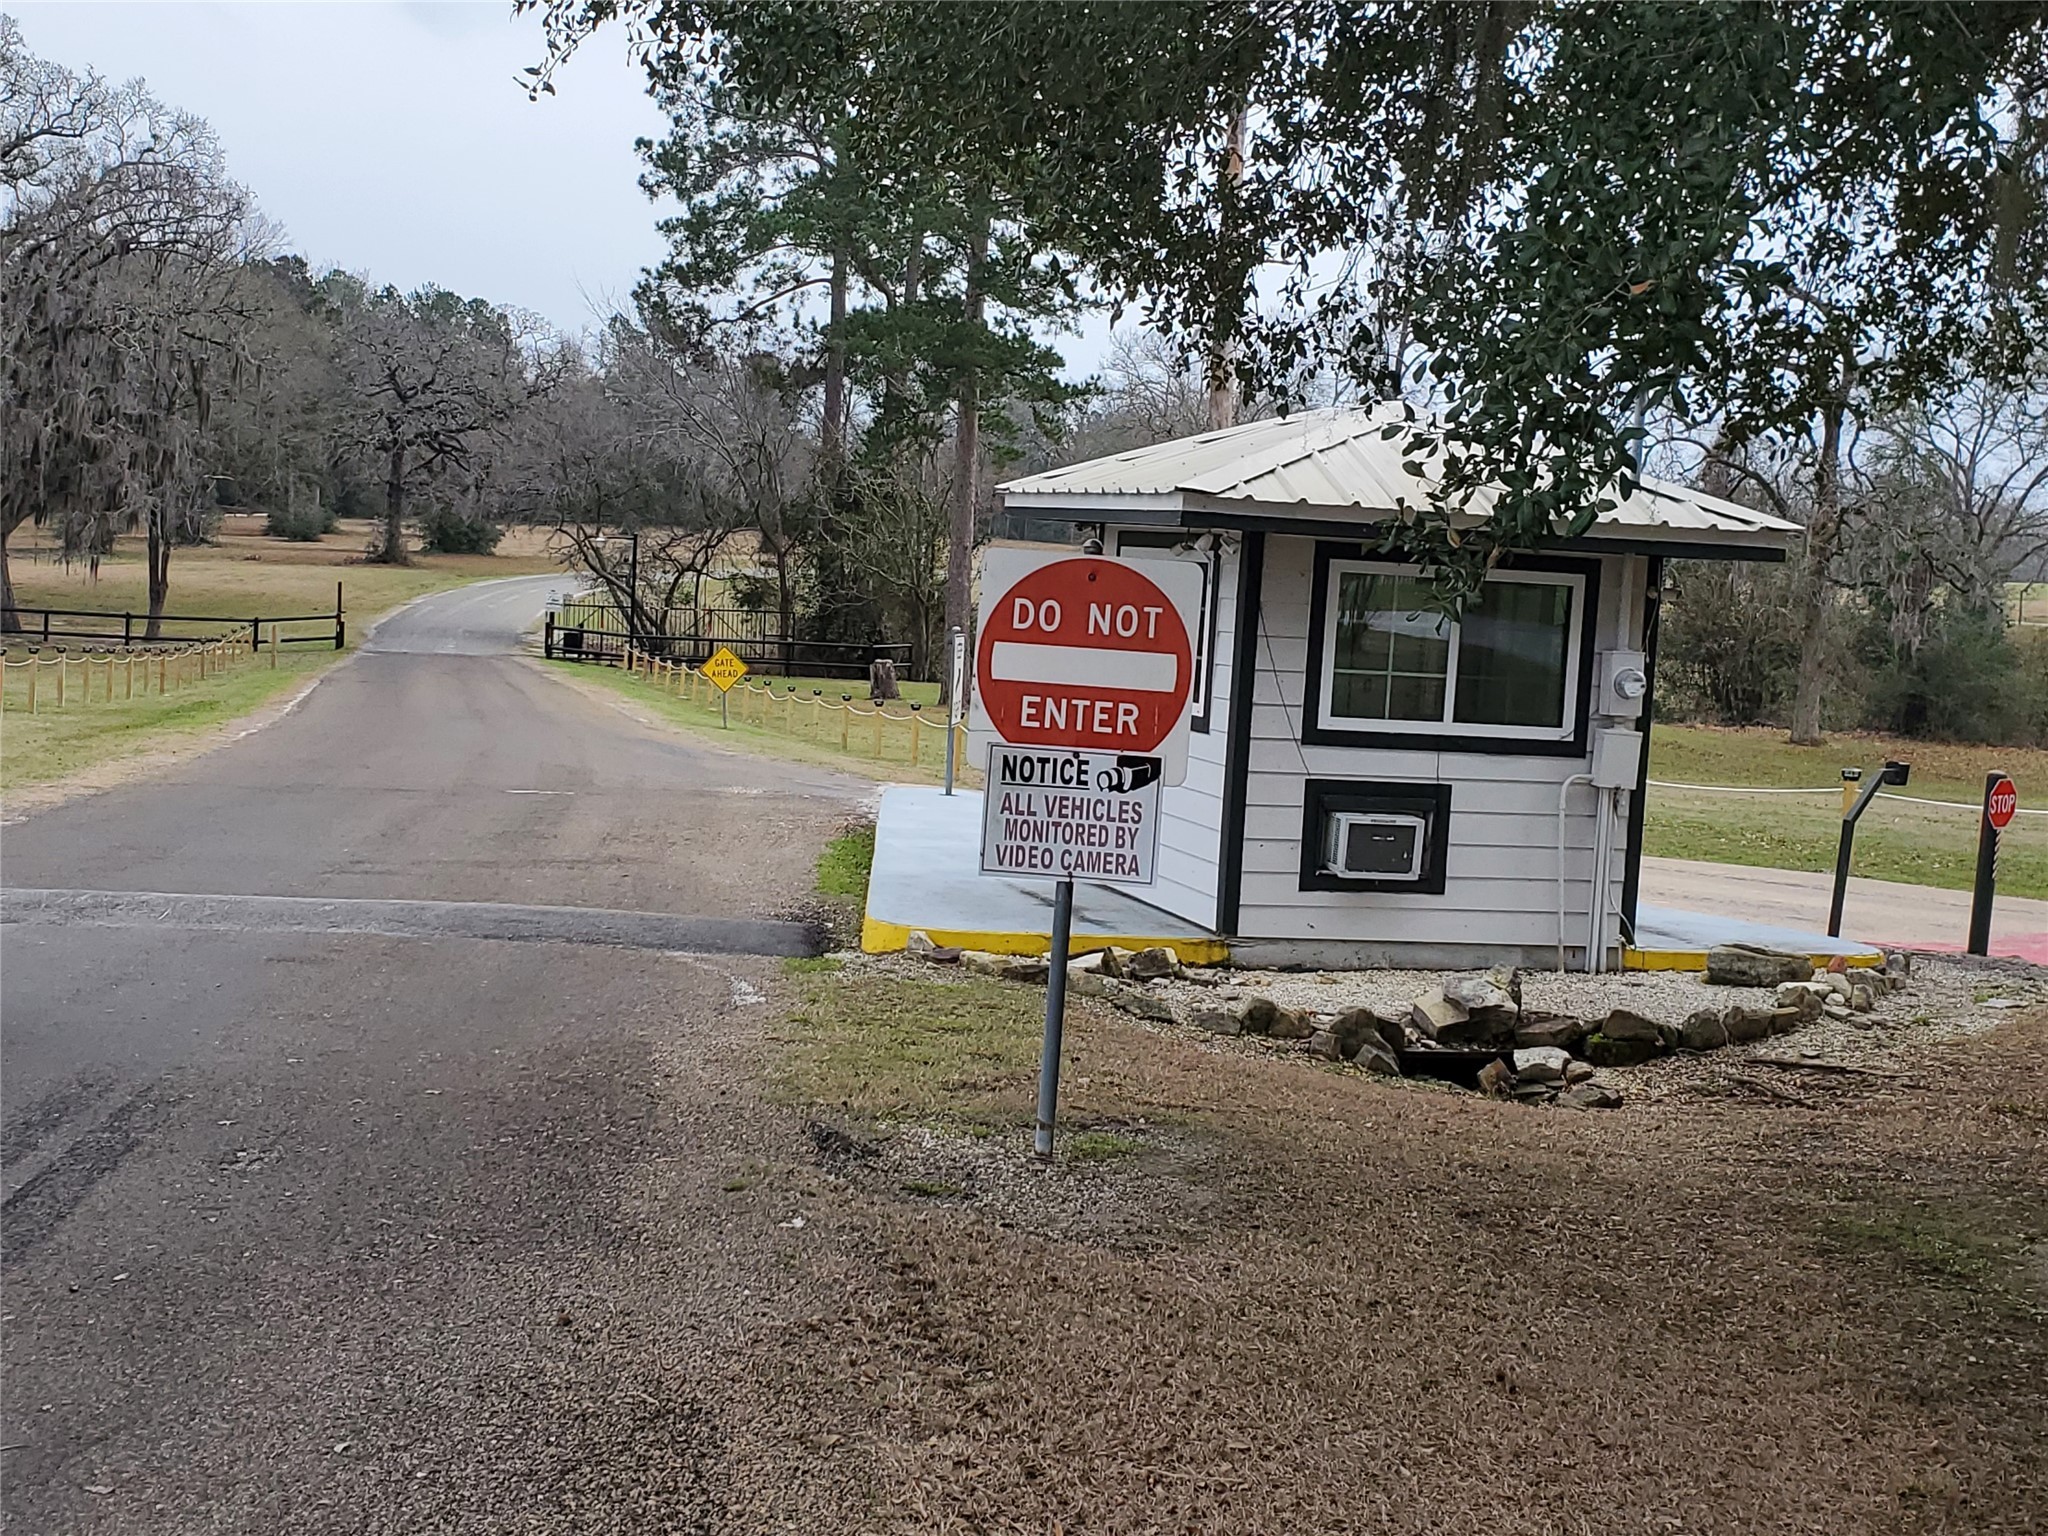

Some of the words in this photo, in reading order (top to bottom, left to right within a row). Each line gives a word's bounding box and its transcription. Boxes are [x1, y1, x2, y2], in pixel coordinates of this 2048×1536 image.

[1012, 597, 1063, 632] DO
[1088, 603, 1163, 639] NOT
[712, 670, 738, 678] AHEAD
[715, 659, 734, 667] GATE
[1020, 695, 1140, 736] ENTER
[1001, 754, 1090, 786] NOTICE
[1000, 792, 1037, 817] ALL
[1044, 795, 1143, 824] VEHICLES
[1991, 795, 2015, 814] STOP
[1004, 819, 1109, 847] MONITORED
[1115, 826, 1140, 850] BY
[995, 844, 1054, 869] VIDEO
[1060, 850, 1140, 877] CAMERA
